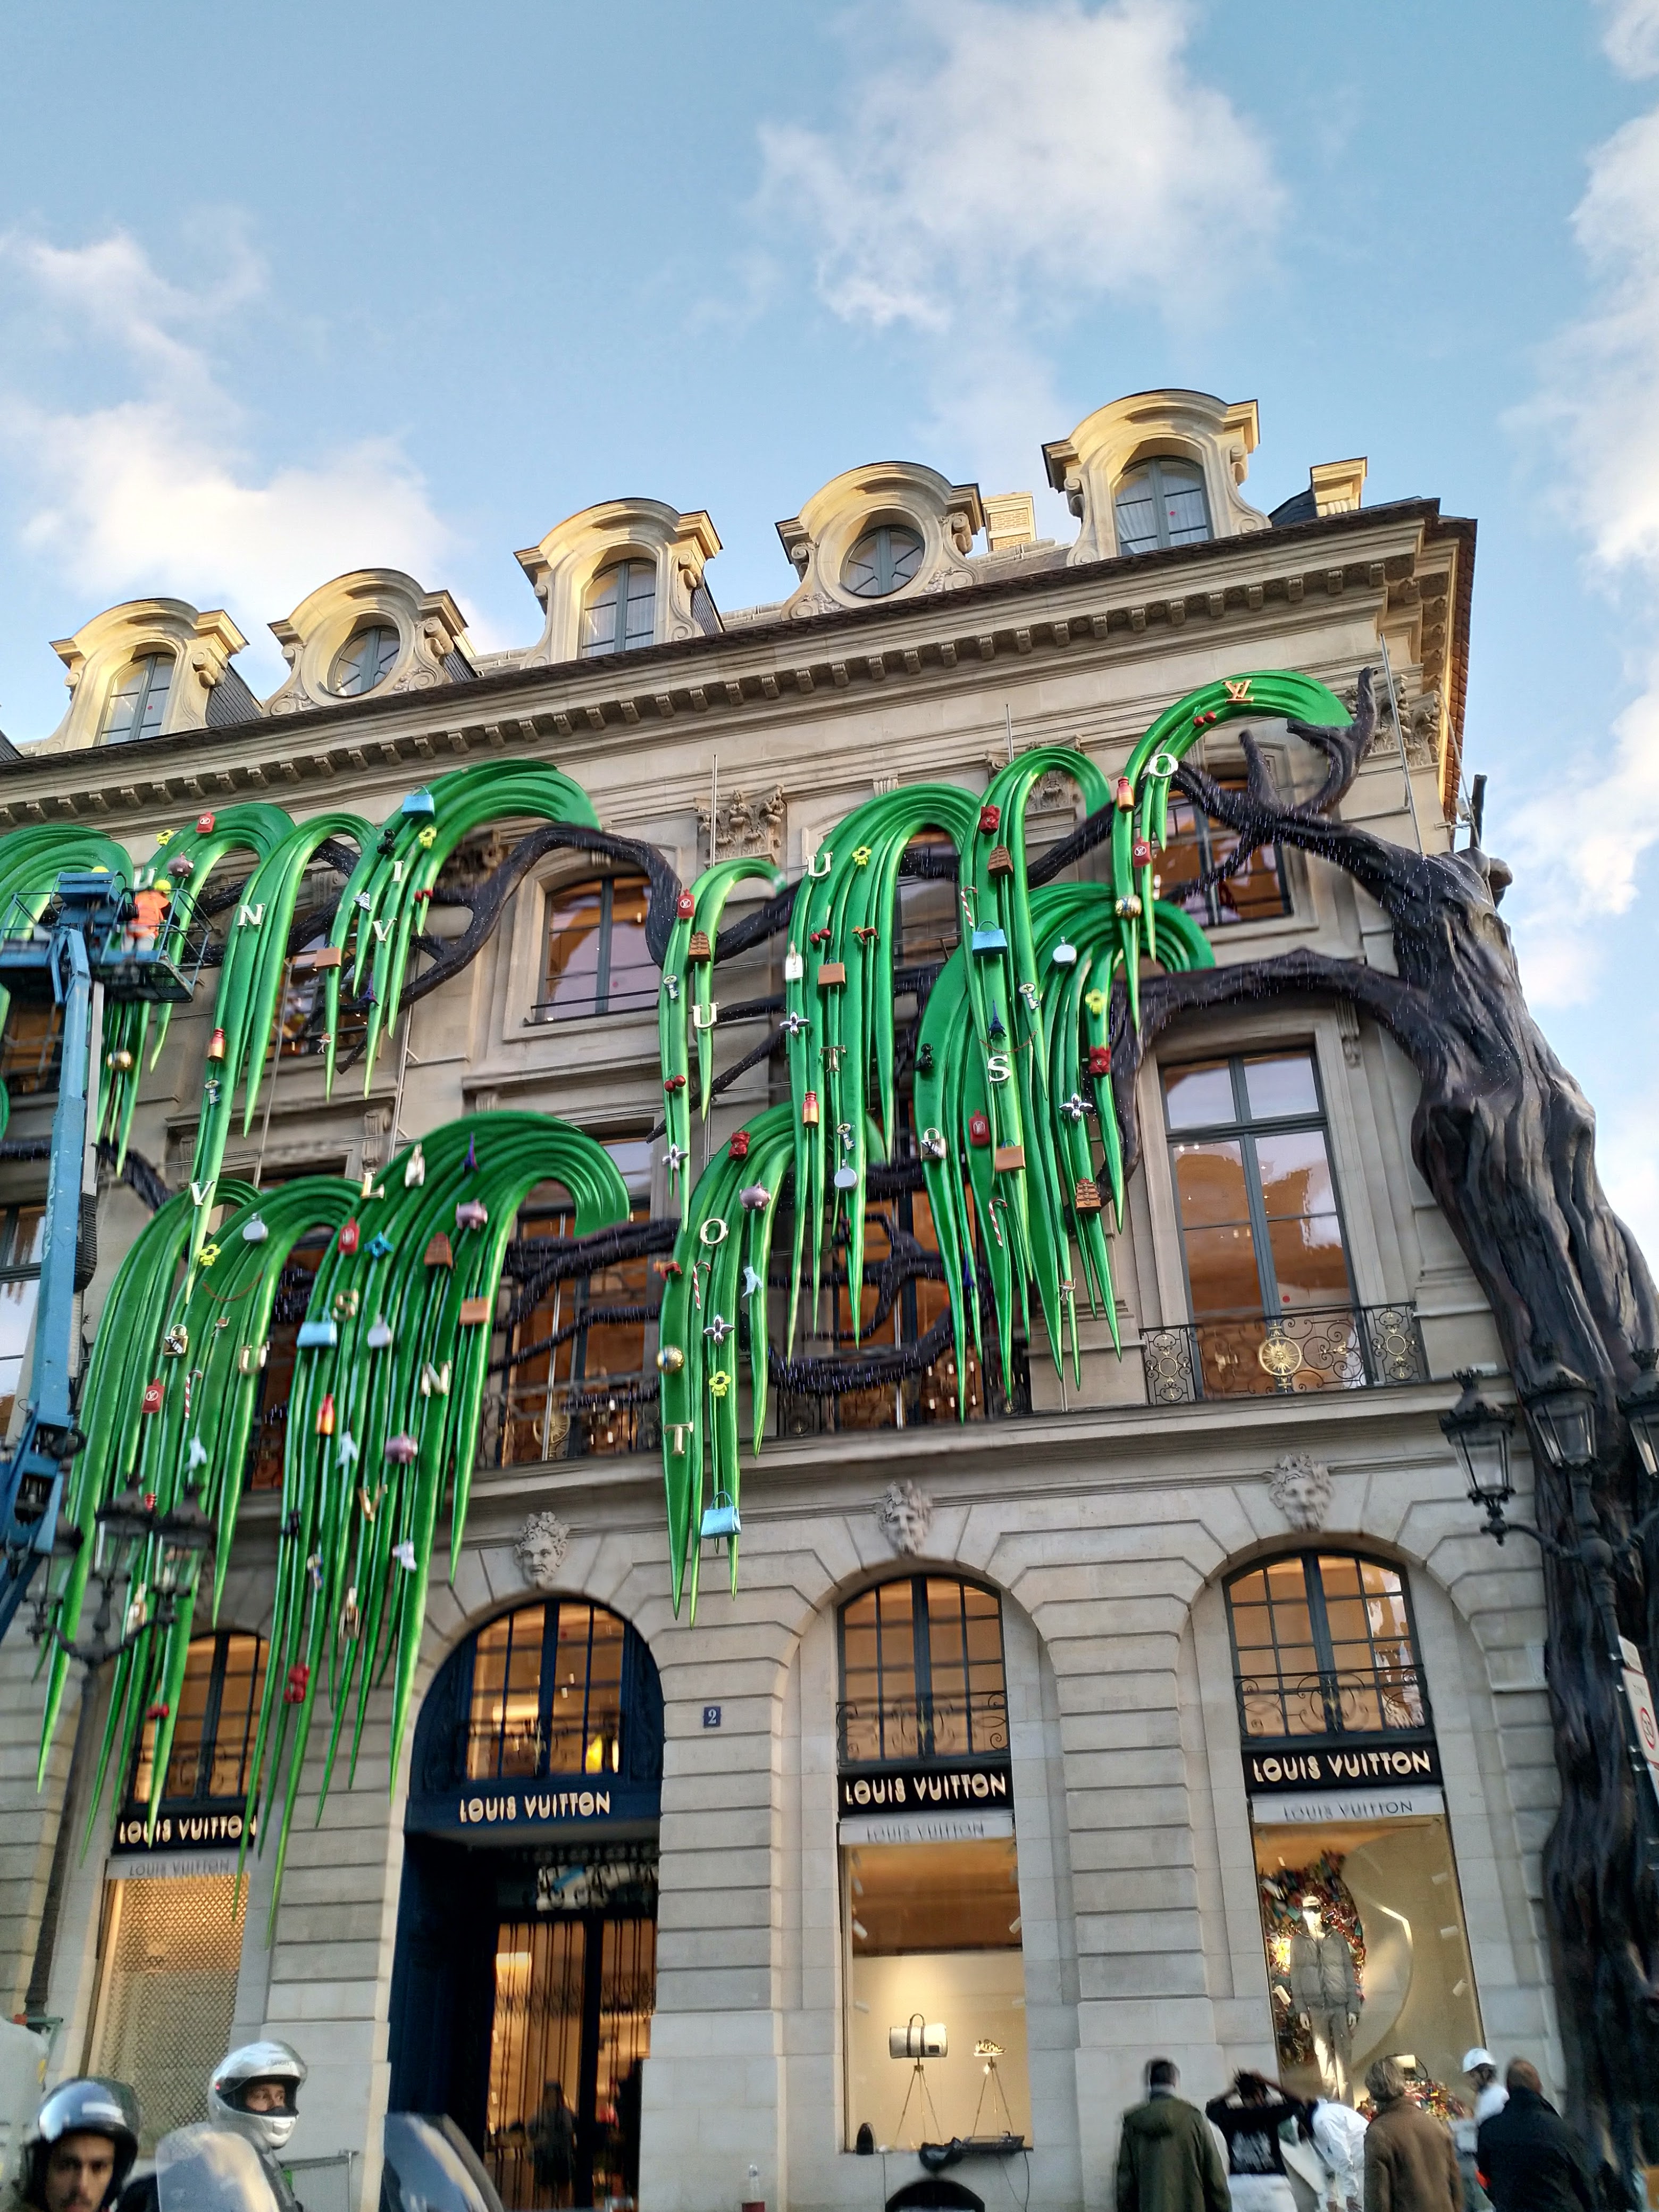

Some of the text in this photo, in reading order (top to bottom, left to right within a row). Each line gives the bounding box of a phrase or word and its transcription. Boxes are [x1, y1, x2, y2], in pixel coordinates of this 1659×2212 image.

[1149, 752, 1179, 778] O
[391, 860, 404, 884] I
[807, 852, 833, 878] U
[237, 903, 266, 928] N
[372, 918, 397, 943] V
[691, 1002, 719, 1029] U
[819, 1044, 846, 1073] T
[986, 1054, 1011, 1084] S
[189, 1180, 217, 1207] V
[361, 1171, 385, 1200] L
[699, 1218, 728, 1246] O
[332, 1288, 359, 1321] S
[421, 1360, 451, 1398] N
[664, 1421, 694, 1456] T
[357, 1484, 388, 1522] V
[708, 1709, 717, 1724] 2
[1252, 1749, 1431, 1782] LOUIS VUITTON
[845, 1772, 1006, 1806] LOUIS VUITTON
[459, 1790, 611, 1824] LOUIS VUITTON
[1284, 1800, 1413, 1822] LOUIS VUITTON
[867, 1820, 985, 1844] LOUIS VUITTON
[129, 1860, 166, 1876] LOUIS
